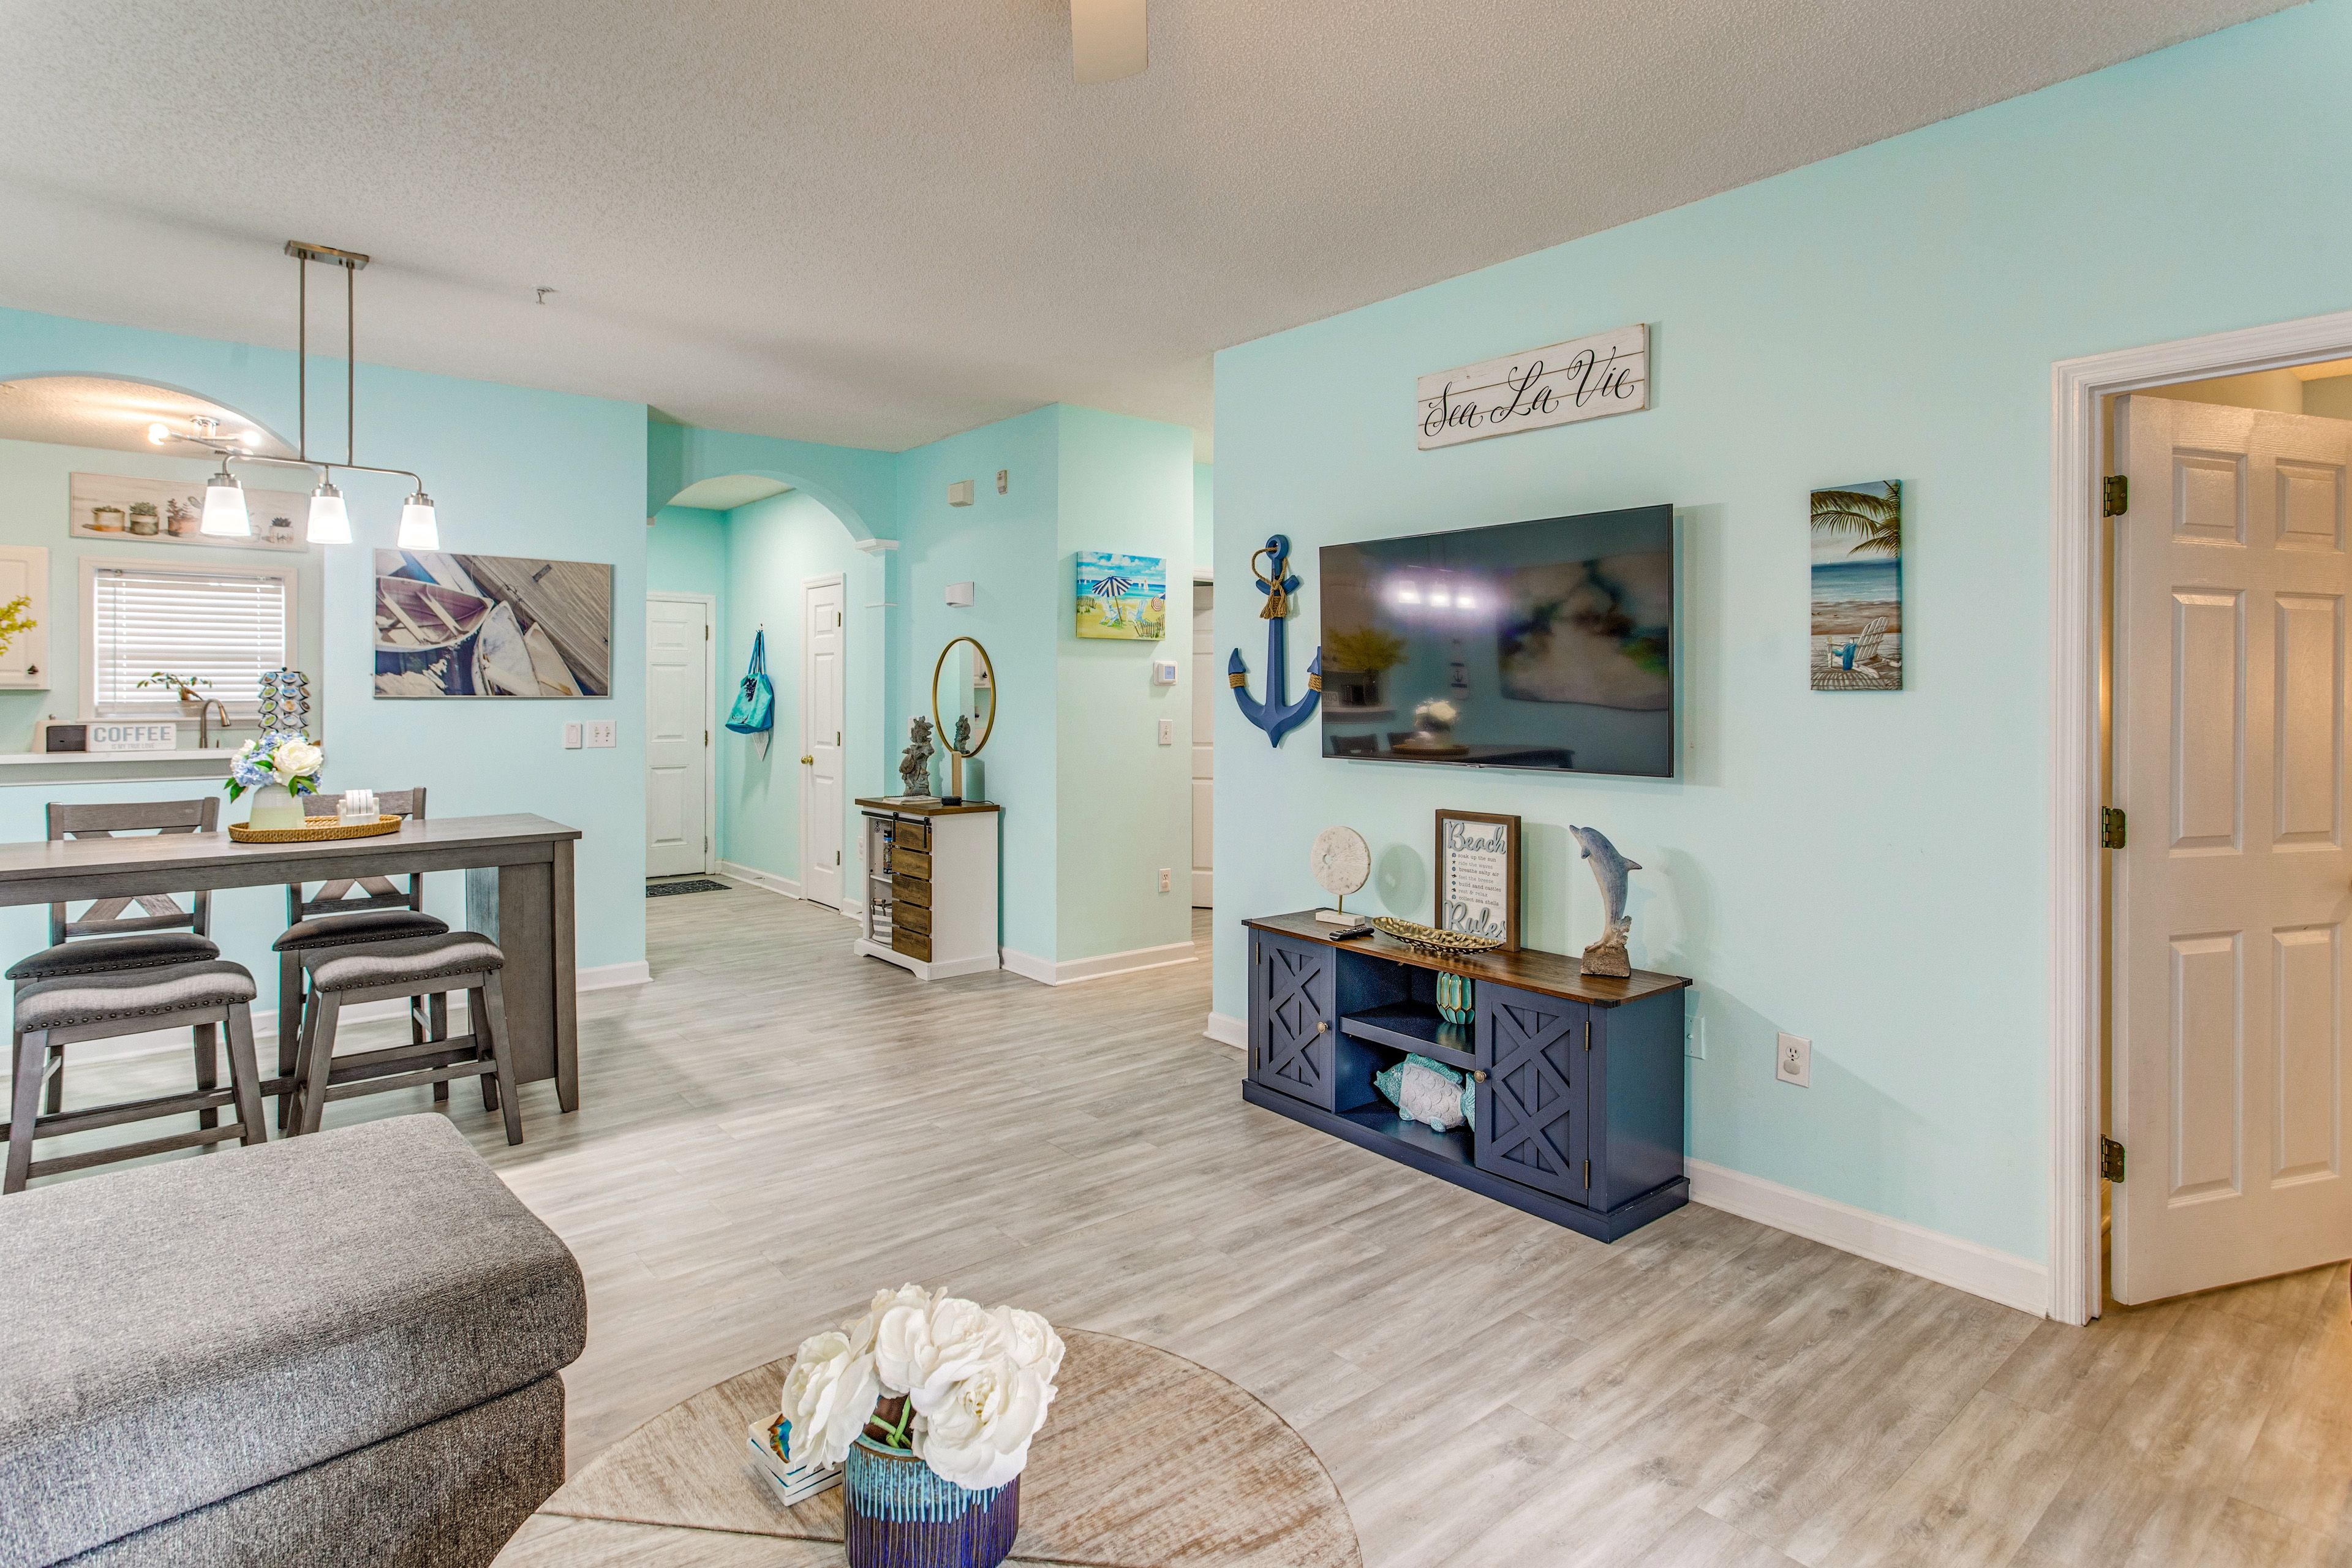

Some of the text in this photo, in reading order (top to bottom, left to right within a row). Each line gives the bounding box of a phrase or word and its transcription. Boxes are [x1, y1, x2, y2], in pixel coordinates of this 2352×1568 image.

[1424, 346, 1634, 437] Sea La Vie
[94, 726, 172, 742] COFFEE
[1444, 820, 1507, 855] Beach
[1444, 900, 1507, 941] Rules
